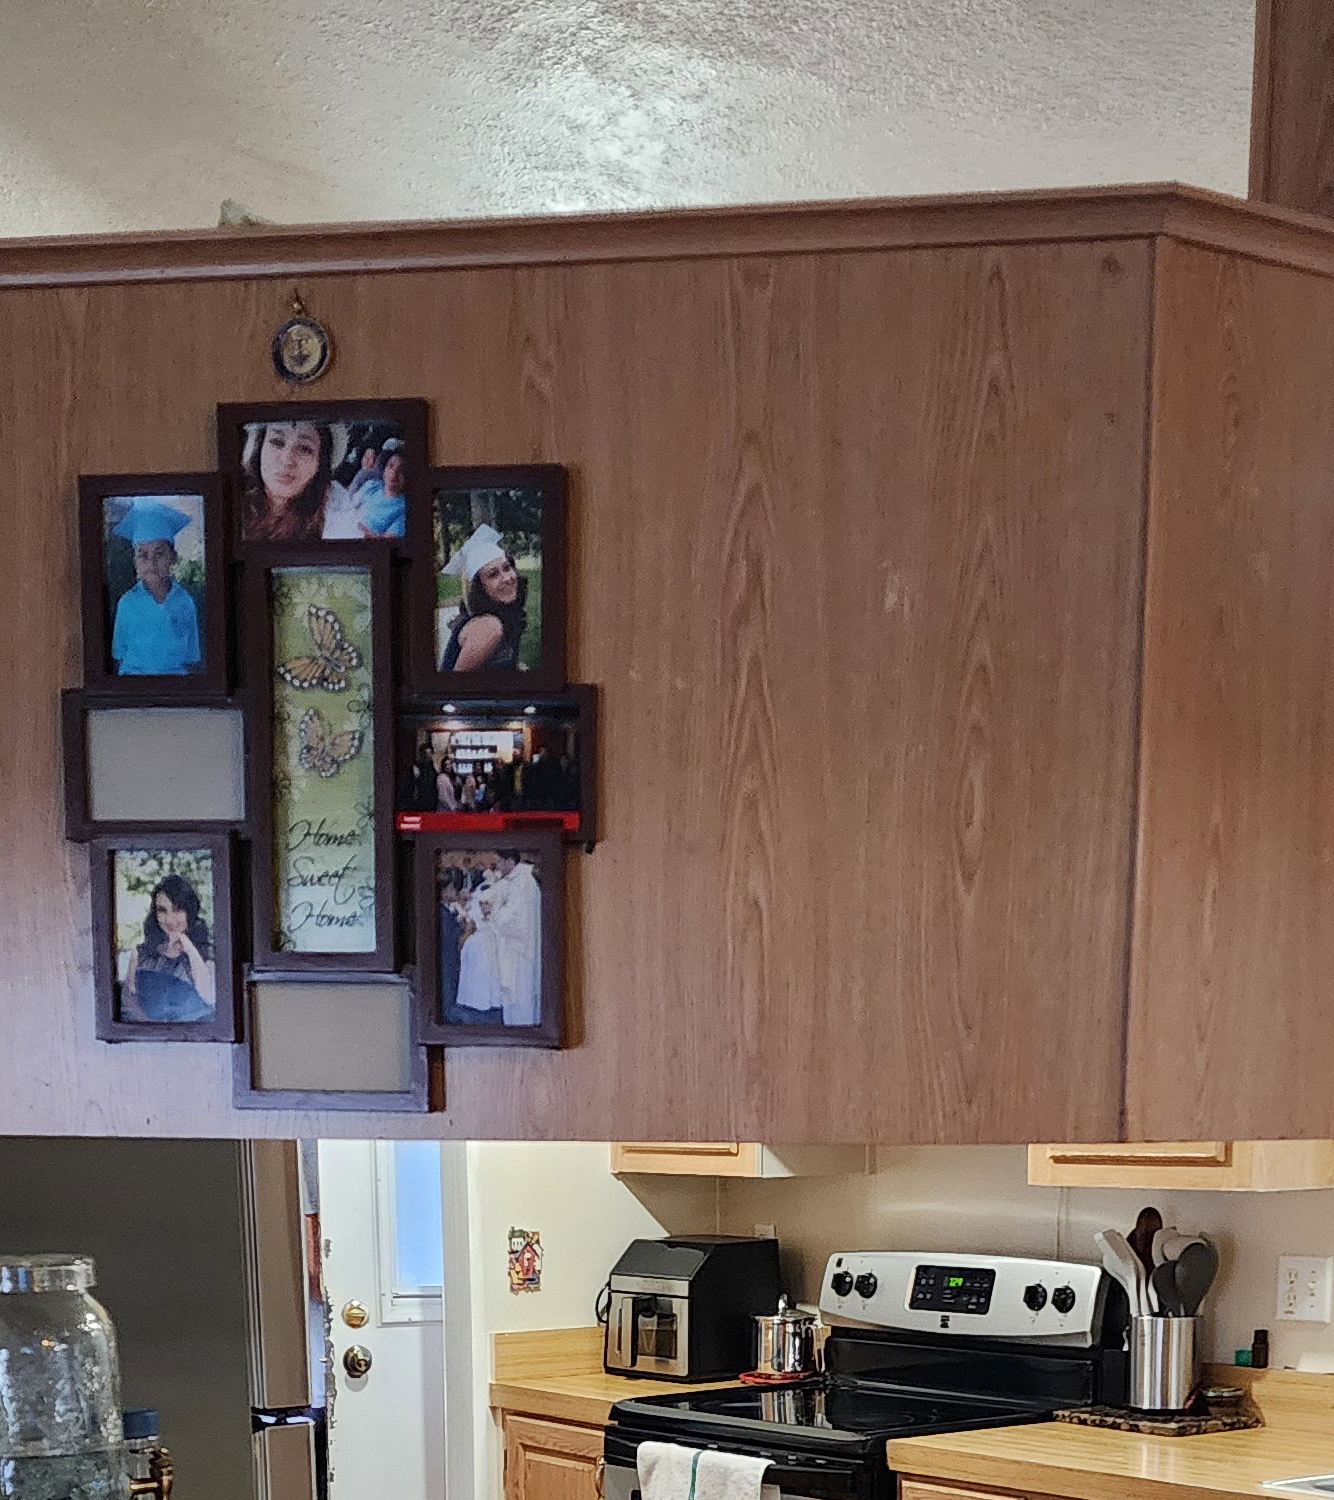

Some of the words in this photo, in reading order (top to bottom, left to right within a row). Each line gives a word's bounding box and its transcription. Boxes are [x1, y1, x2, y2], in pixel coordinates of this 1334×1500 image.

[286, 818, 360, 852] Home
[287, 854, 357, 905] Sweet
[287, 900, 361, 933] Home
